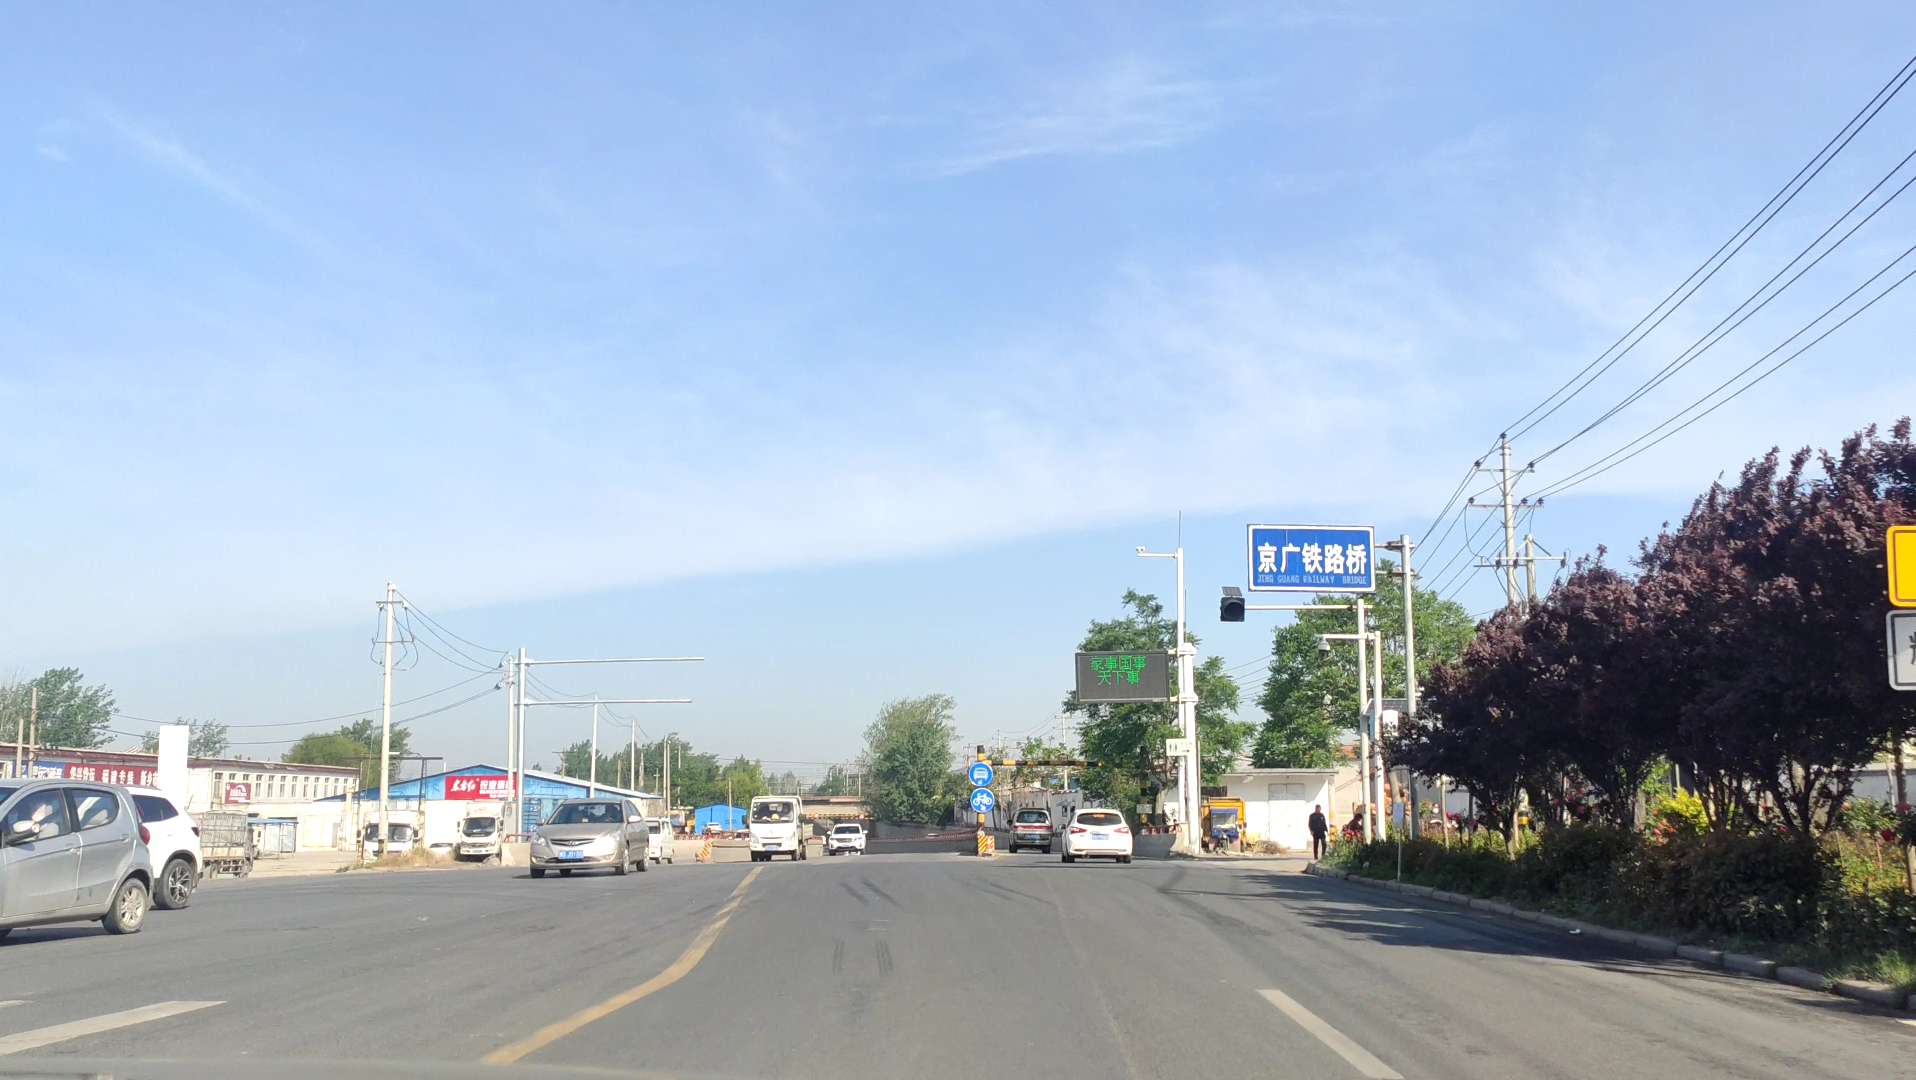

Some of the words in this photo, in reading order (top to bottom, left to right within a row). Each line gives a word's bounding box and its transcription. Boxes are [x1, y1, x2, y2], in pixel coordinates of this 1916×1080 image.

[1257, 542, 1368, 575] 京广铁路桥
[1277, 574, 1300, 584] GUANG
[1303, 575, 1335, 584] RAILWAY
[1342, 575, 1367, 585] BRIDGE
[1090, 655, 1147, 671] 家事国事
[1097, 669, 1140, 686] 天下事
